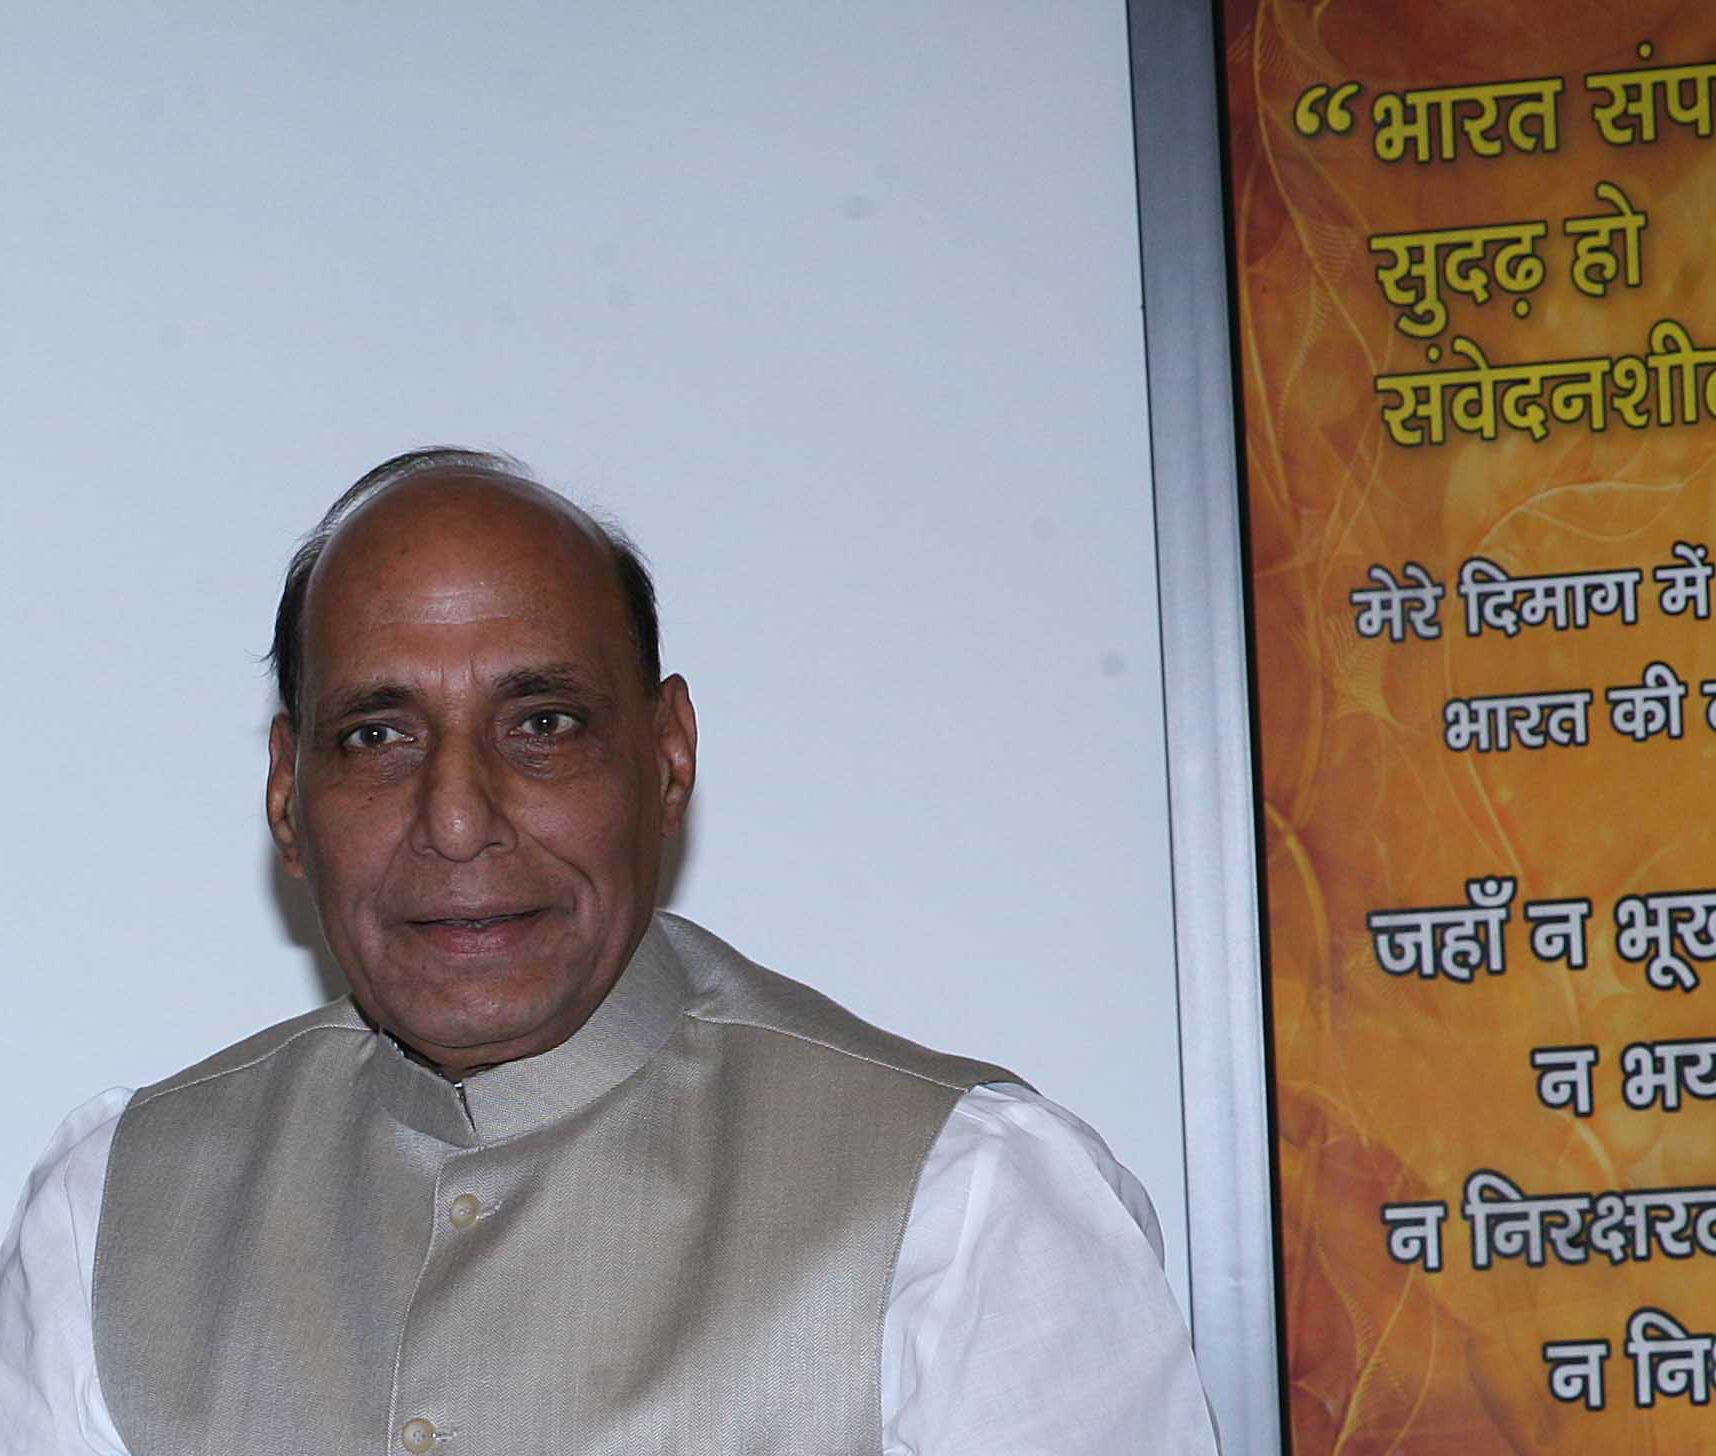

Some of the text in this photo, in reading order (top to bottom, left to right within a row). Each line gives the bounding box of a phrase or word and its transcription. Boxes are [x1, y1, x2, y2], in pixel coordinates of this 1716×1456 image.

[1565, 181, 1647, 297] हो
[1351, 541, 1714, 642] मेरे दिमाग में
[1444, 690, 1592, 753] भारत
[1608, 661, 1687, 741] की
[1368, 875, 1516, 983] जहाँ
[1524, 897, 1592, 970] न
[1530, 1044, 1598, 1116] न
[1382, 1201, 1447, 1273] न
[1543, 1306, 1716, 1411] न नि
